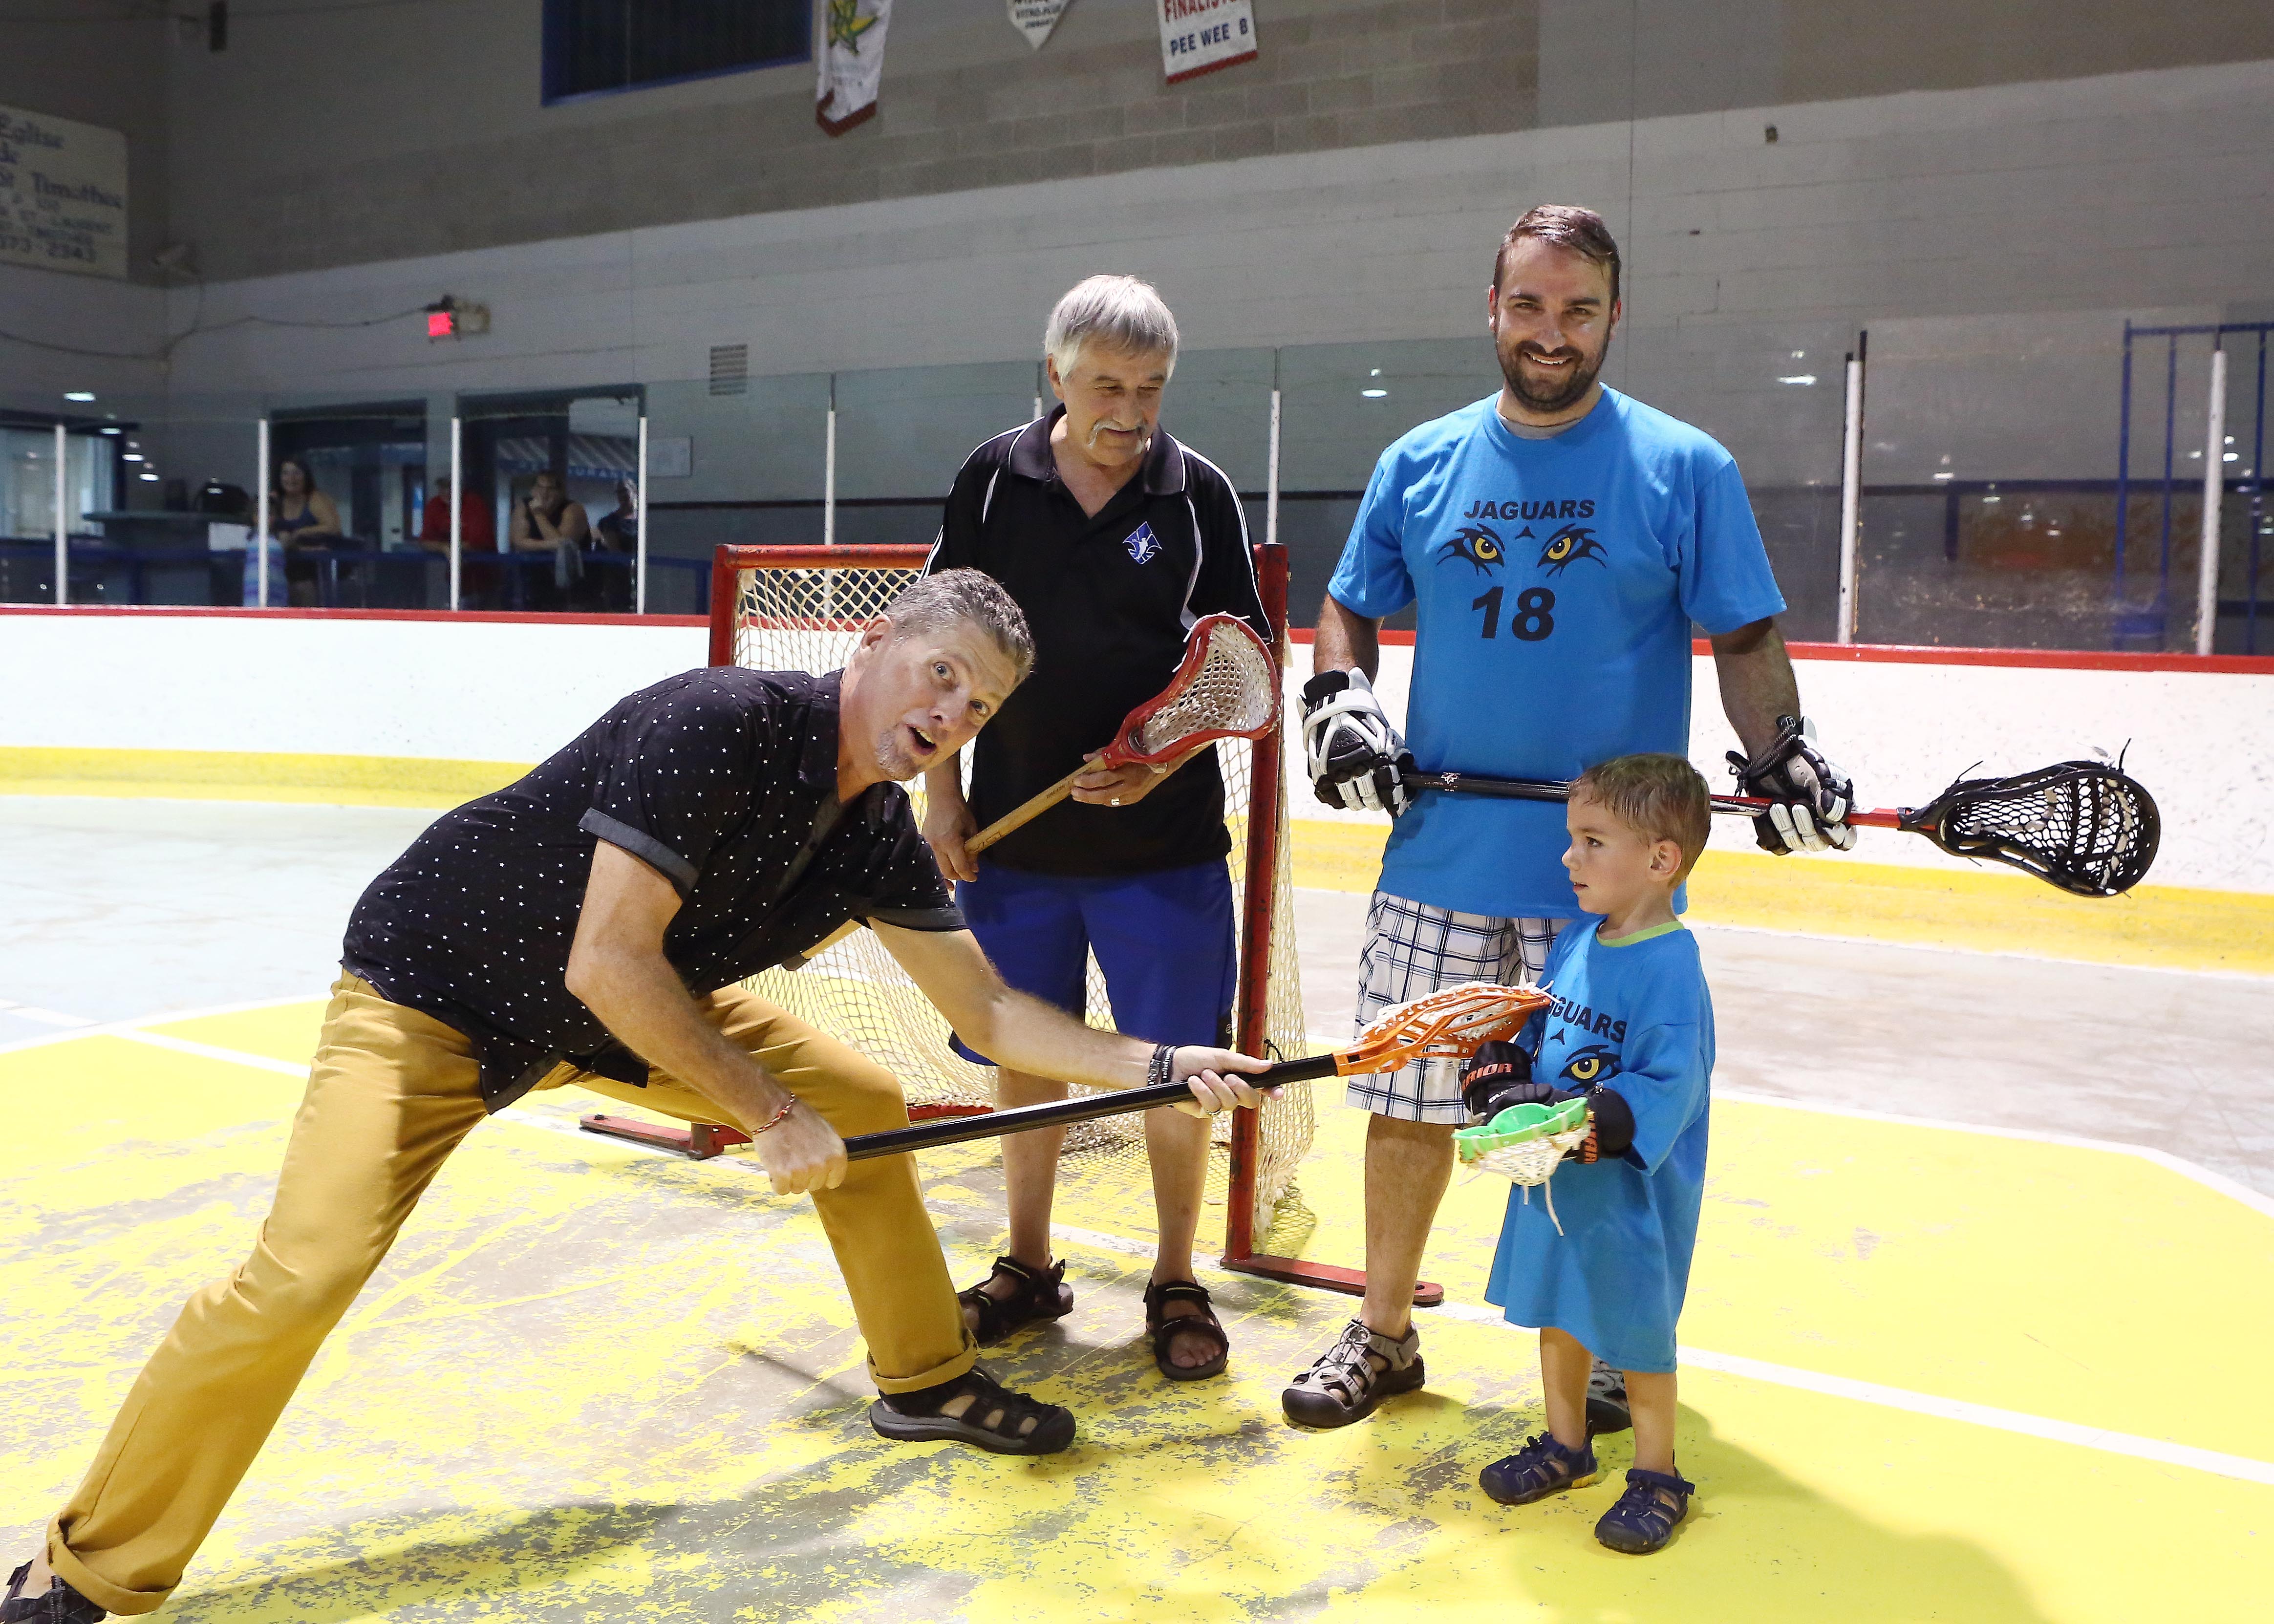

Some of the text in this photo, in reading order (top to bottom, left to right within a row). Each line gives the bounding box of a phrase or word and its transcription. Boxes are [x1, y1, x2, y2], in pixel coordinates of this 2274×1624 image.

[1171, 17, 1248, 56] PEE WEE B
[1464, 499, 1596, 520] JAGUARS
[1472, 586, 1556, 641] 18
[1549, 993, 1628, 1043] GUARS
[1462, 1063, 1513, 1091] RIOR
